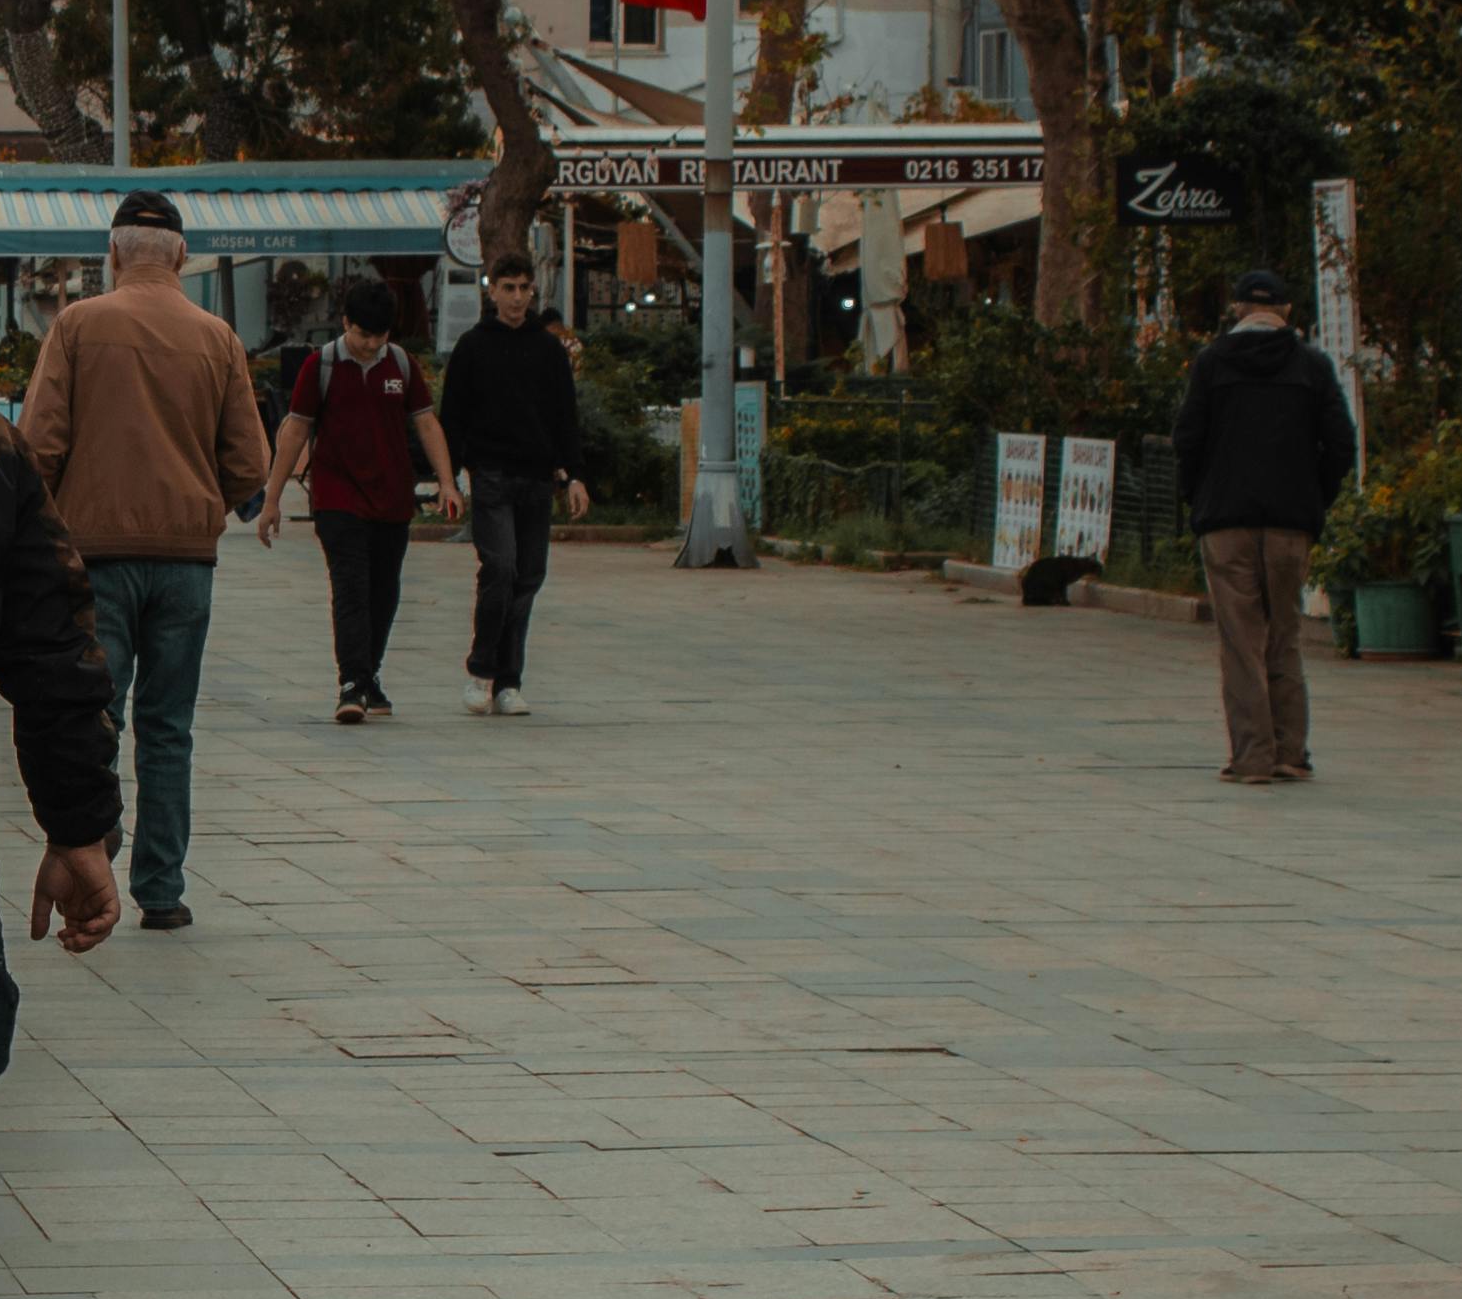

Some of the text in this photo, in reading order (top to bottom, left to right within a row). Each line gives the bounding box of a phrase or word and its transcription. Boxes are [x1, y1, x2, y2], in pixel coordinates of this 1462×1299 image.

[553, 161, 659, 184] RGUVAN
[680, 159, 842, 184] RETAURANT
[905, 160, 959, 180] 0216
[972, 159, 1009, 179] 351
[1127, 161, 1223, 216] Zehra
[211, 234, 296, 249] KÖŞEM CAFE
